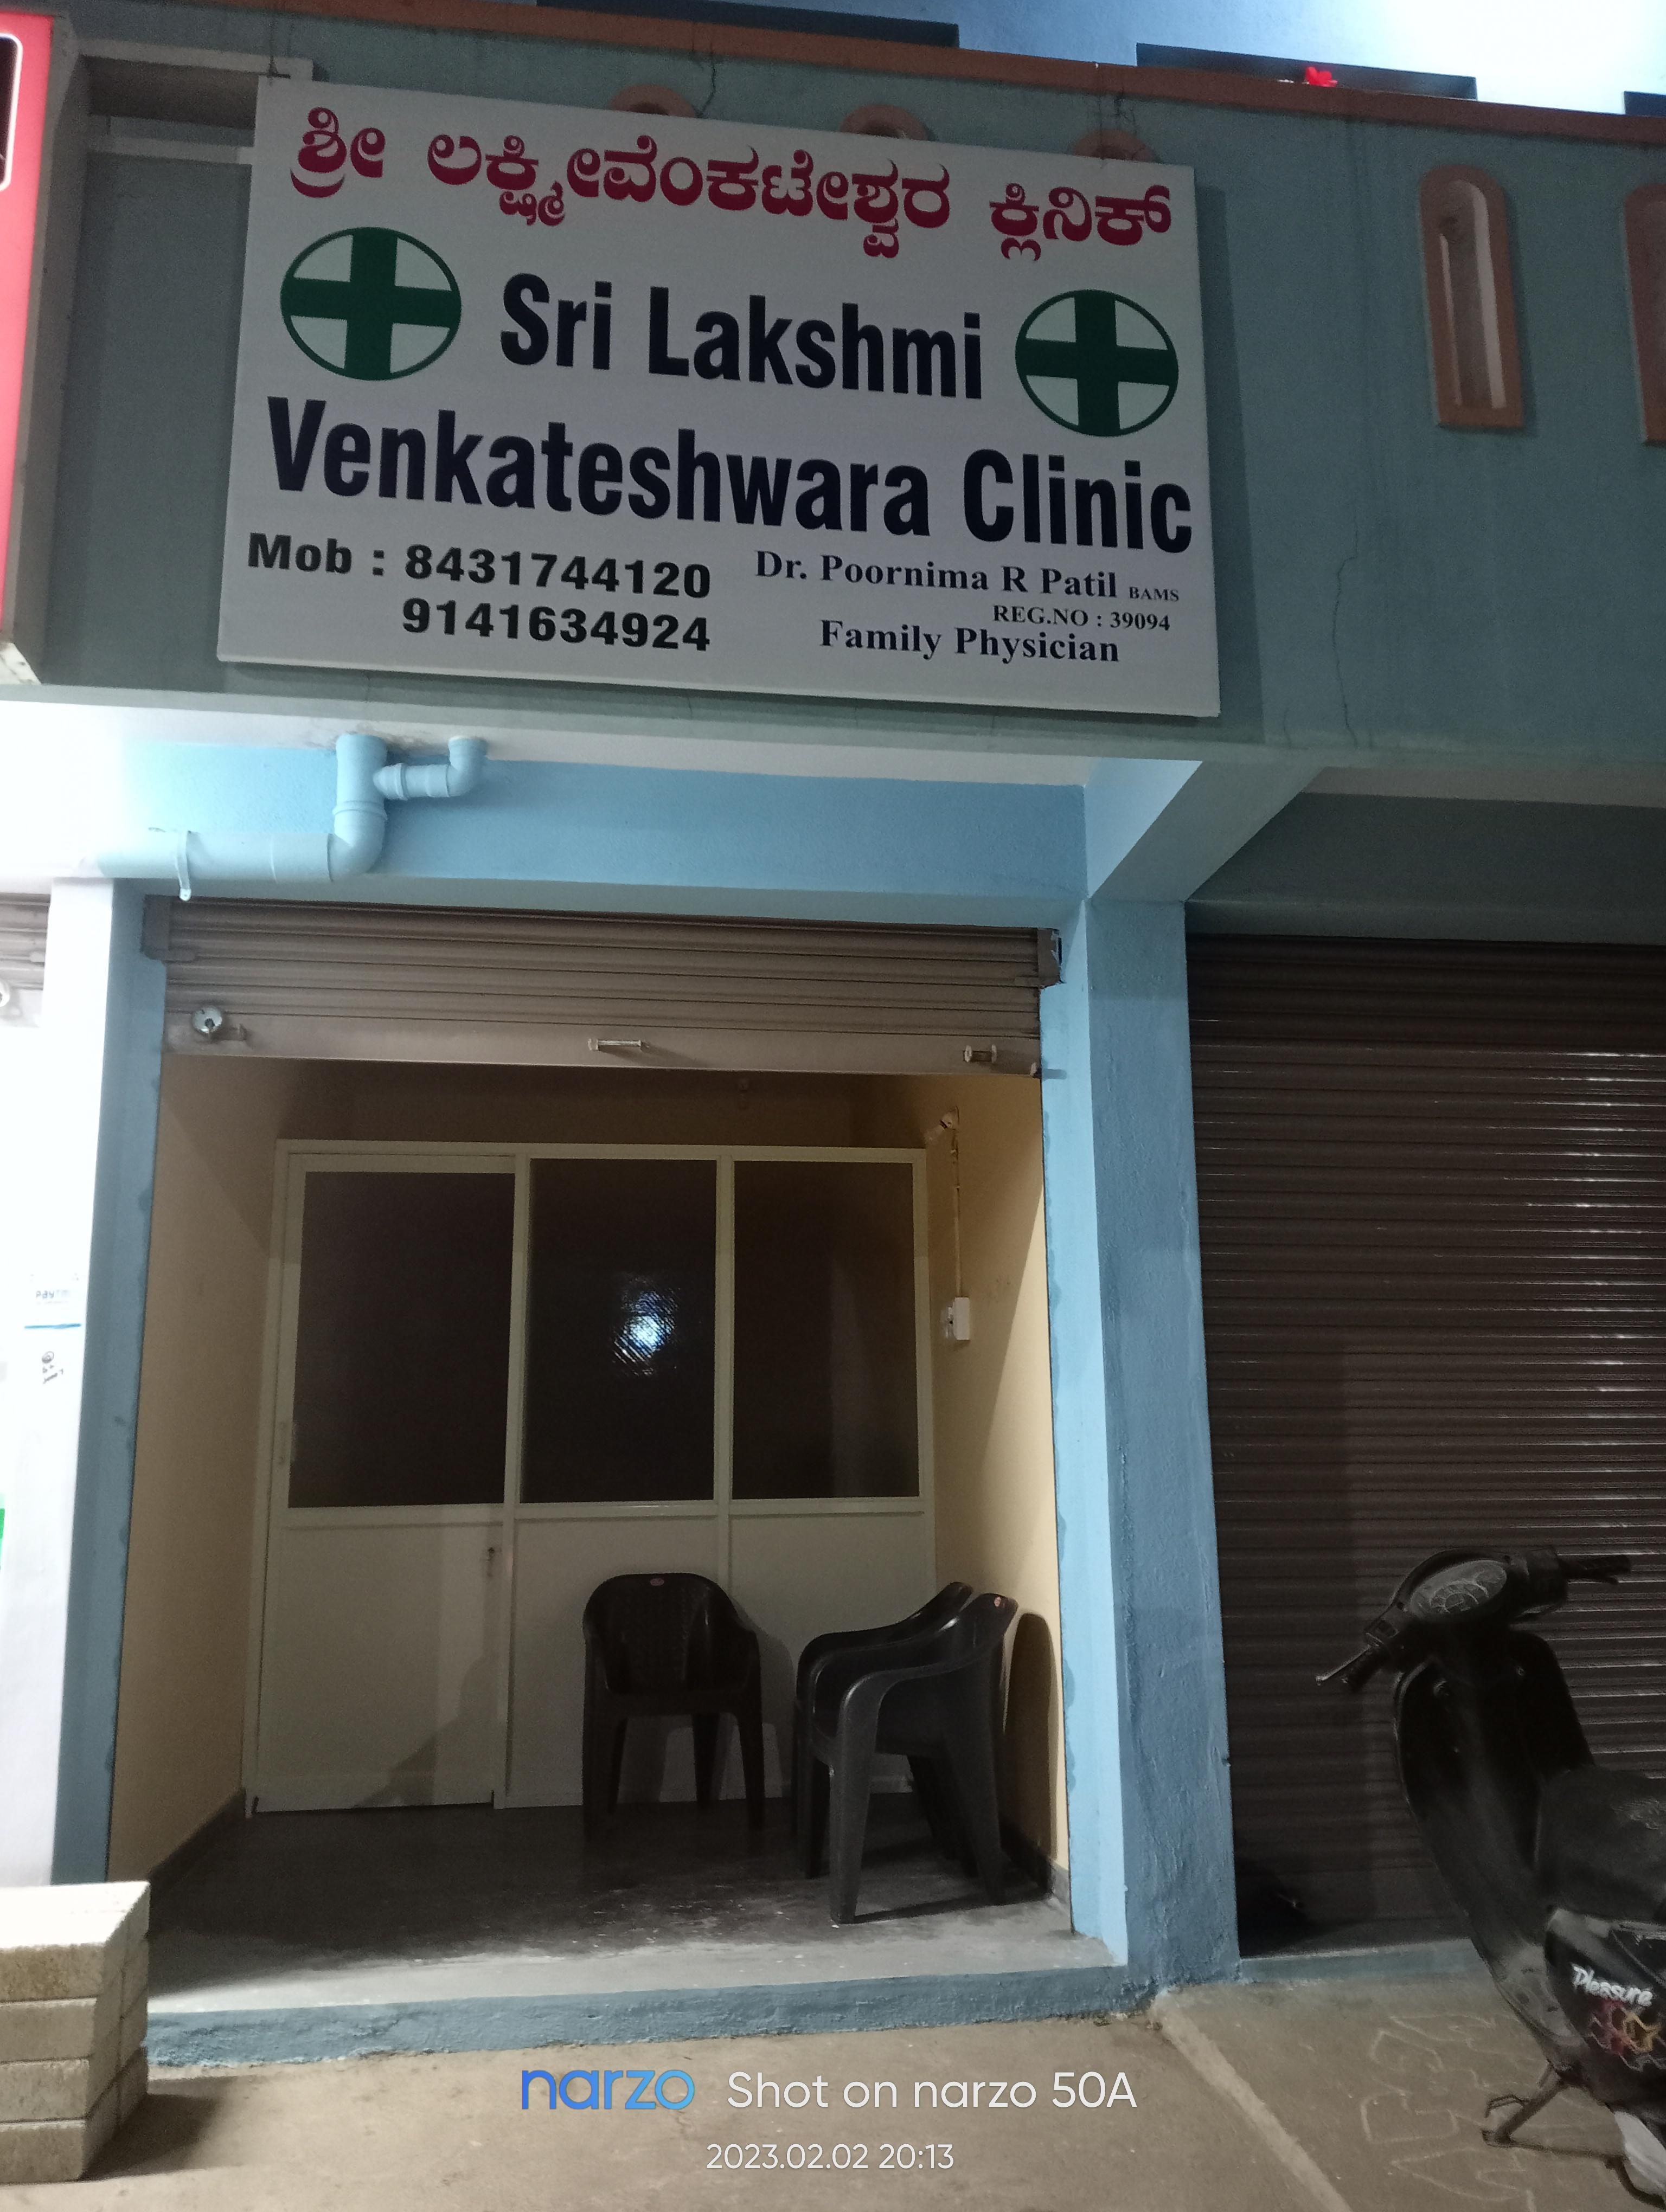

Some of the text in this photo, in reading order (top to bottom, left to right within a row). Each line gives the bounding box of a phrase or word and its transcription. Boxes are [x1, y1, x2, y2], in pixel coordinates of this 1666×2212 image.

[291, 107, 386, 198] ಶ್ರೀ
[990, 183, 1171, 261] ಕ್ಲಿನಿಕ್
[501, 273, 981, 399] Sri Lakshmi
[266, 396, 1191, 553] Venkateshwara Clinic
[248, 533, 351, 574] Mob
[405, 544, 710, 599] 8431744120
[757, 551, 1179, 601] Dr. Poornima R Patil BAMS
[402, 597, 710, 651] 9141634924
[822, 620, 1119, 664] Family Physician
[994, 605, 1088, 626] REG.NO
[1110, 612, 1170, 631] 39094
